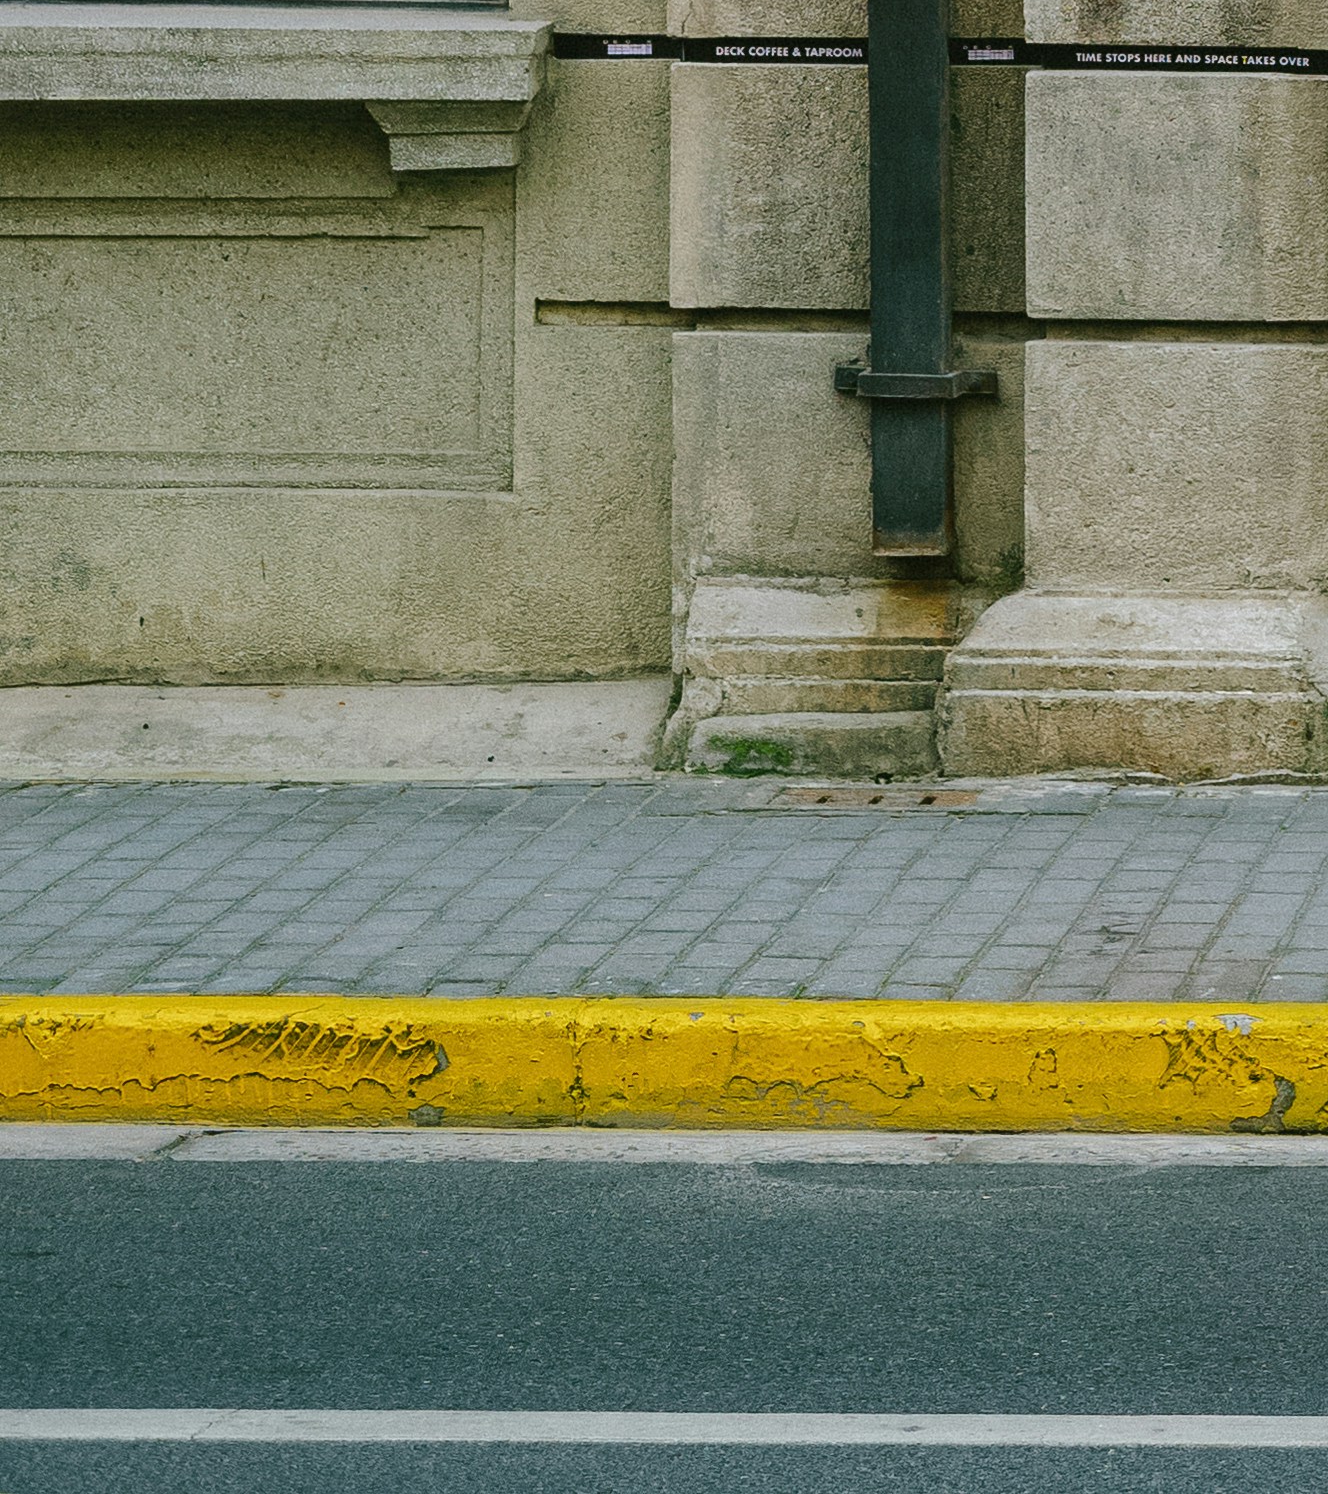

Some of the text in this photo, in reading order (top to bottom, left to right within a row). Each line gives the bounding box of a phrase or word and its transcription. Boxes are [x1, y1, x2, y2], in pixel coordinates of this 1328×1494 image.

[715, 46, 863, 57] DECK COFFEE & TAPROOM
[1076, 53, 1310, 67] TIME STOPS HERE AND SPACE TAKES OVER
